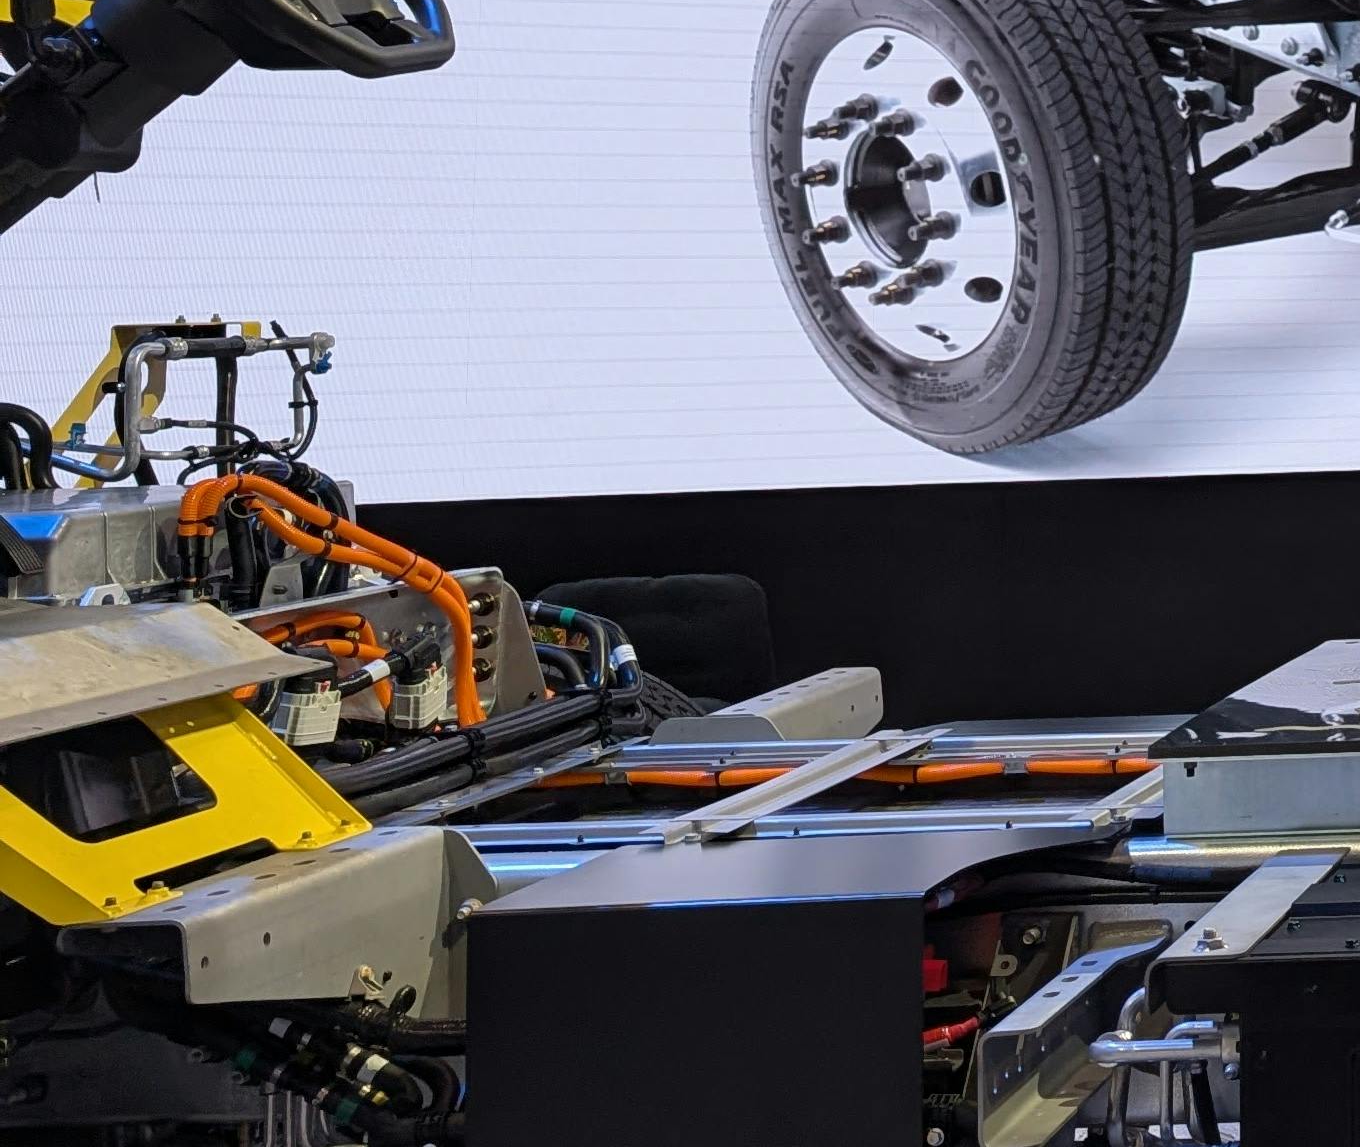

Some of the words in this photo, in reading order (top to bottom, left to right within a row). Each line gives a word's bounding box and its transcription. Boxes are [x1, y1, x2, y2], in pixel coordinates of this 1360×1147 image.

[770, 60, 795, 134] RSA
[770, 143, 796, 234] MAX
[795, 249, 843, 341] FUEL
